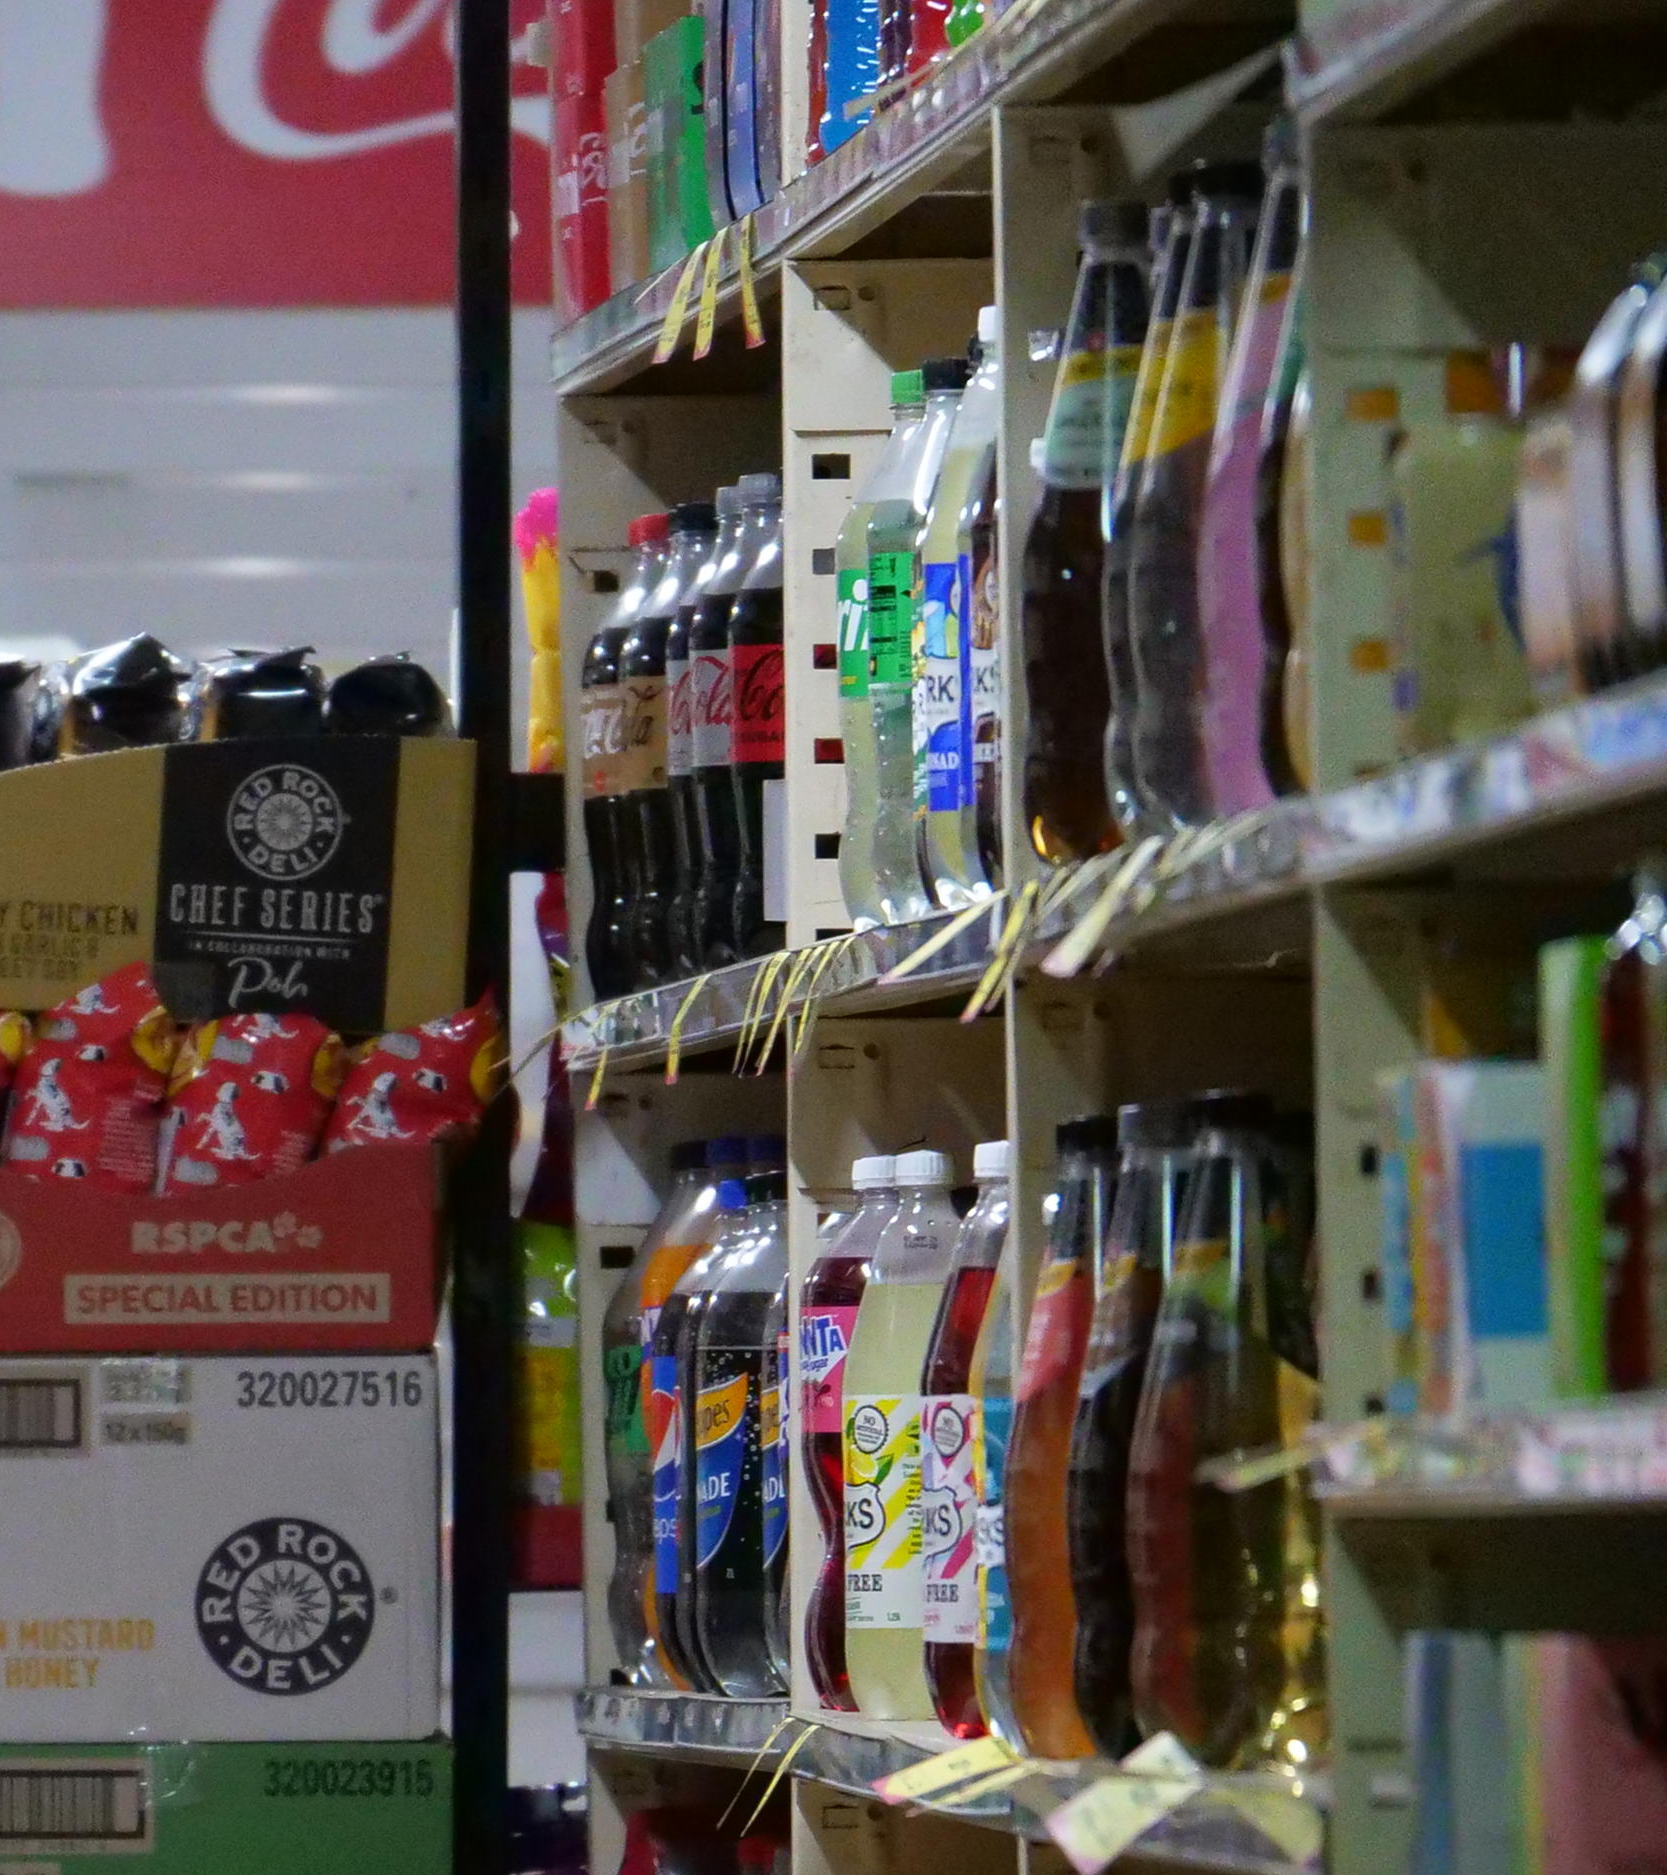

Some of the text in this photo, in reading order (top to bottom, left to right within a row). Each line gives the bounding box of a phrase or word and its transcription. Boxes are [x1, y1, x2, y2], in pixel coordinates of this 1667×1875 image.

[232, 769, 339, 835] RED ROCK
[252, 846, 320, 875] DELI
[20, 900, 139, 936] CHICKEN
[170, 883, 375, 934] CHEF SERIES
[129, 1219, 275, 1254] RSPCA
[77, 1284, 378, 1315] SPECIAL EDITION
[236, 1371, 424, 1408] 320027516
[202, 1523, 367, 1625] RED ROCK
[18, 1619, 156, 1652] MUSTARD
[230, 1648, 345, 1691] DELI
[263, 1758, 435, 1799] 320023915
